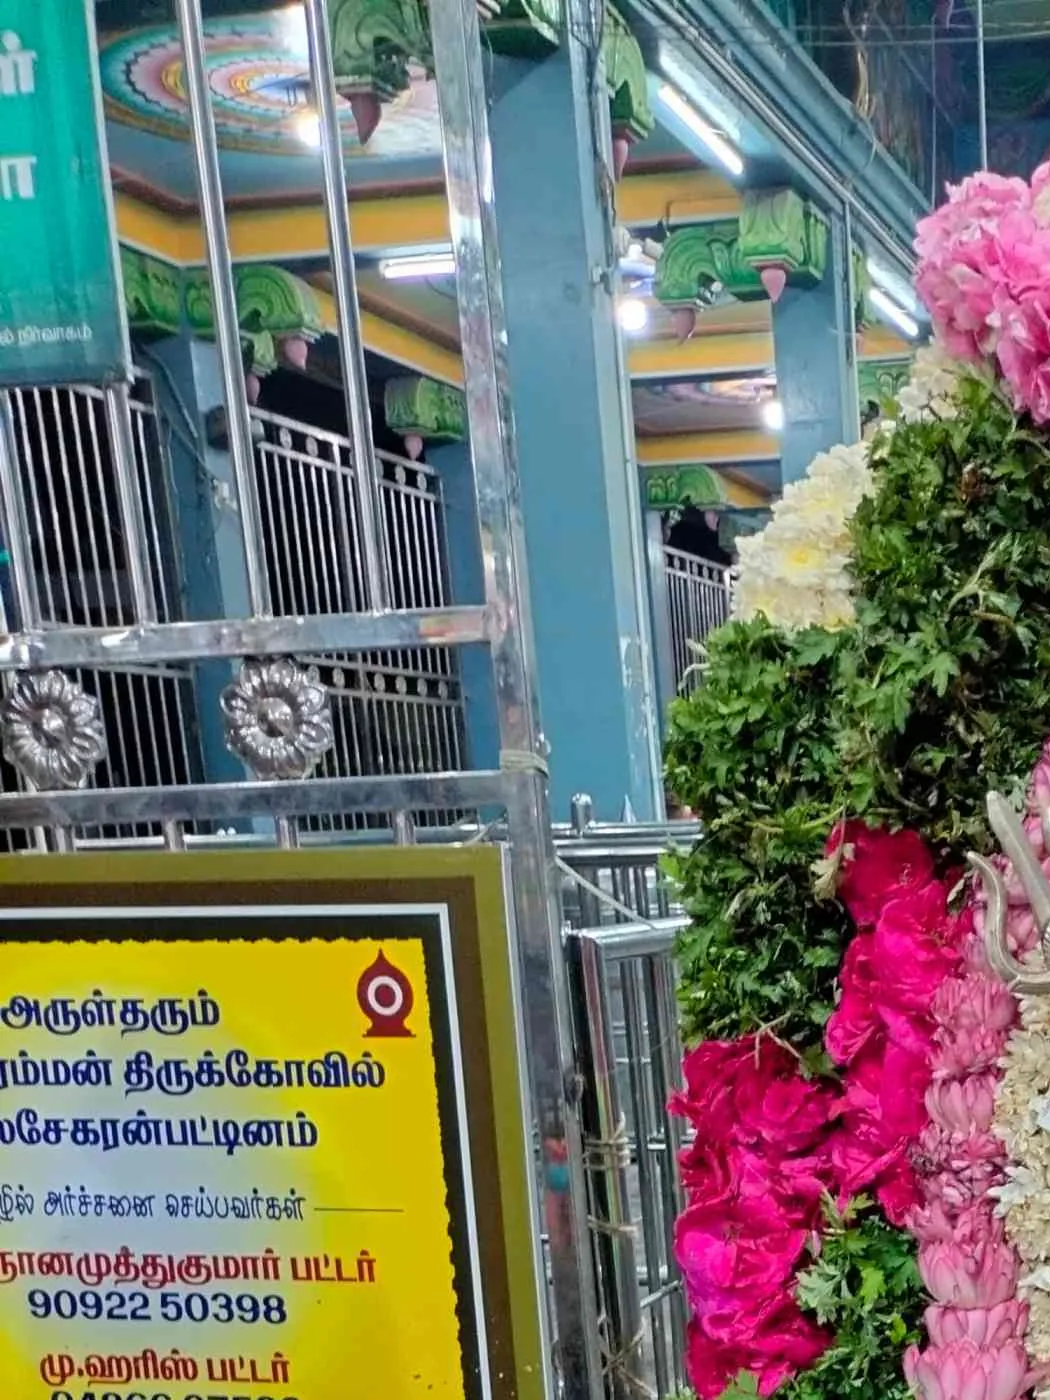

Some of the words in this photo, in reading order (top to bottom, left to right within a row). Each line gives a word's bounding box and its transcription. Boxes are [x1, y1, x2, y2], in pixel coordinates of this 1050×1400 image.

[124, 1050, 385, 1098] திருக்கோவில்
[44, 1185, 155, 1217] அர்ச்சனை
[165, 1186, 305, 1221] செய்பவர்கள்
[291, 1250, 376, 1283] பட்டர்
[28, 1289, 152, 1321] 90922
[161, 1293, 287, 1324] 50398
[207, 1352, 290, 1384] பட்டர்
